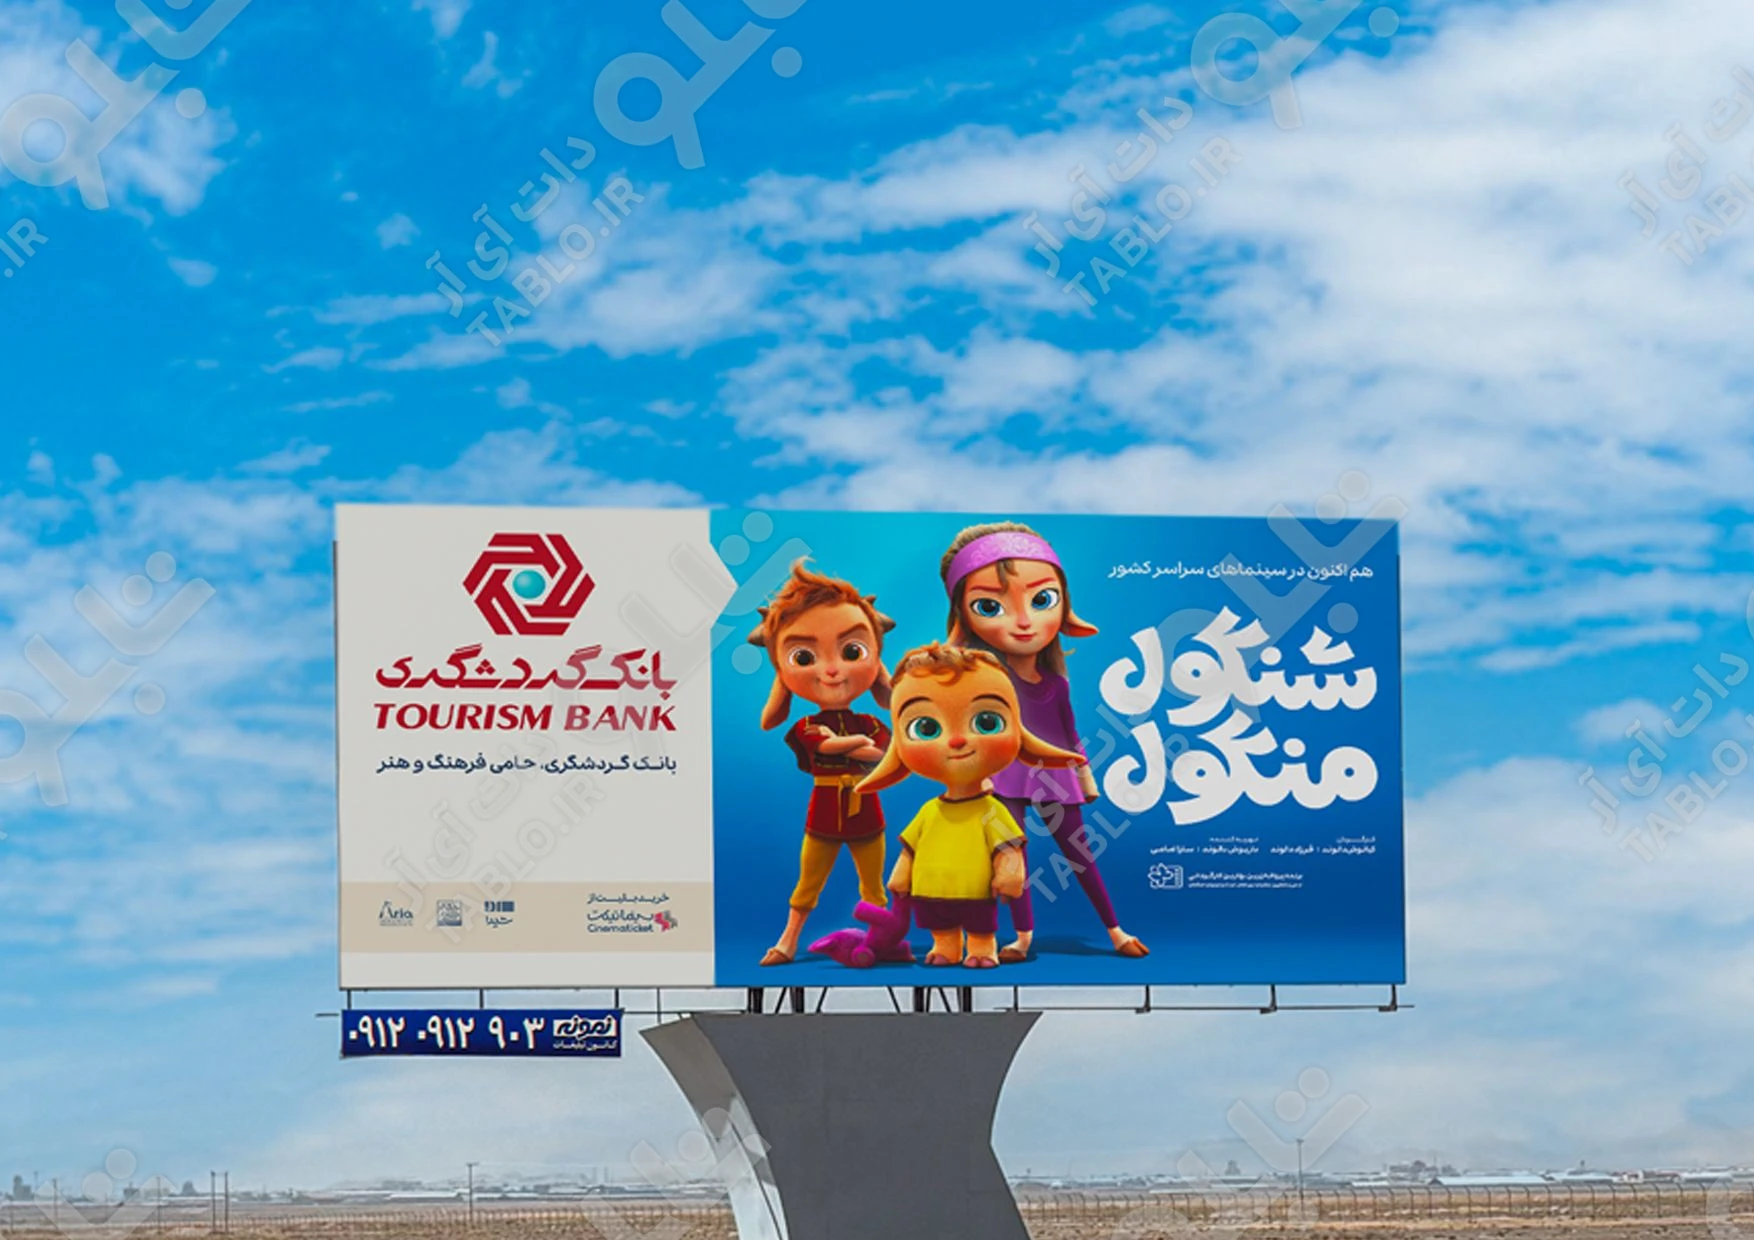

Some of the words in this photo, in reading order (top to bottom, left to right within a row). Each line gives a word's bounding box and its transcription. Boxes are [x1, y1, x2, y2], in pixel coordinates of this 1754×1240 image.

[1107, 561, 1151, 578] کشور
[1152, 560, 1204, 579] سراسر
[1206, 561, 1286, 579] سینماهای
[1286, 566, 1305, 580] در
[1307, 563, 1348, 580] اکنون
[1349, 565, 1373, 582] هم
[375, 643, 602, 689] گردشگری
[578, 648, 678, 700] بانک
[1099, 605, 1377, 727] شنگول
[374, 703, 553, 731] TOURISM
[564, 704, 678, 732] BANK
[376, 756, 410, 774] هنر
[412, 759, 425, 774] و
[427, 752, 487, 774] فرهنگ
[489, 755, 537, 774] حامی
[633, 755, 677, 775] بانک
[1103, 709, 1378, 825] منگول
[350, 1016, 405, 1049] ۰۹۱۲
[418, 1016, 475, 1049] ۰۹۱۲
[489, 1016, 544, 1049] ۹۰۳
